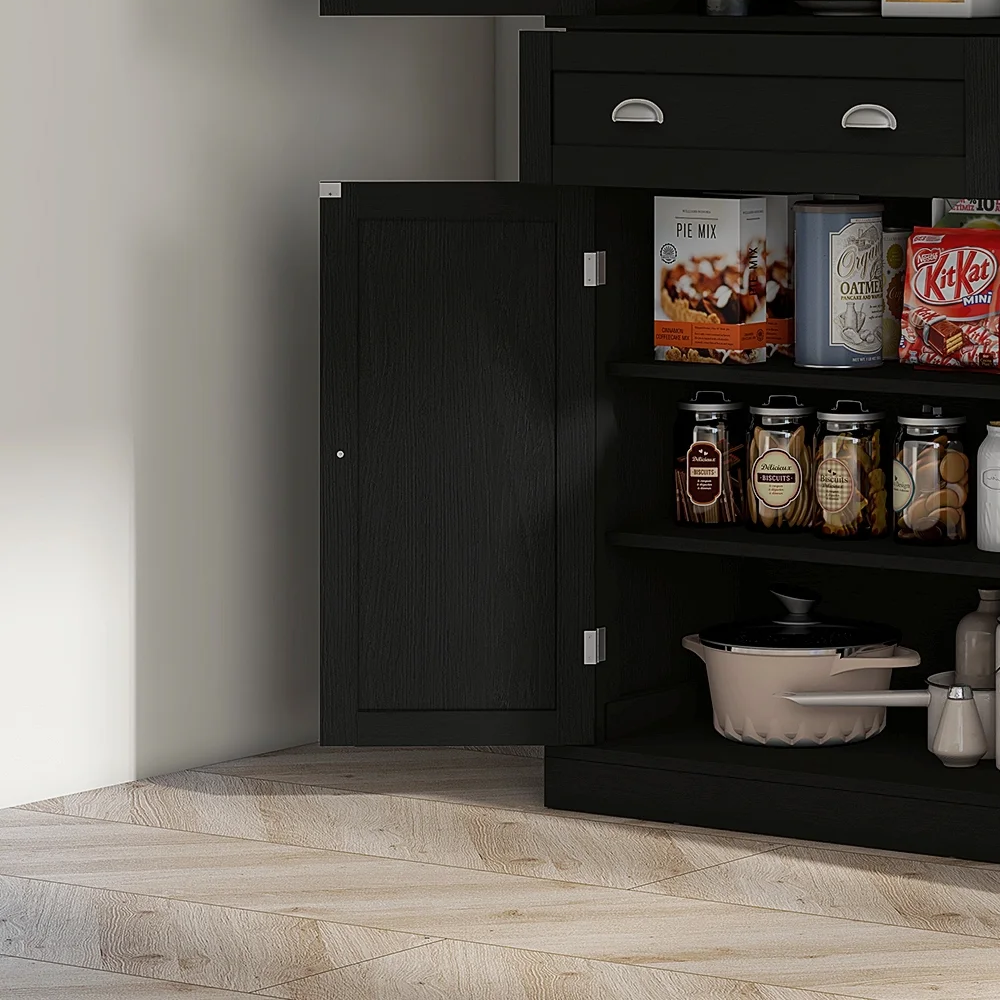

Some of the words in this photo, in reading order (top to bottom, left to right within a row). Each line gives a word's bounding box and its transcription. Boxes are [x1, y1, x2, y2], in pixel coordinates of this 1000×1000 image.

[676, 222, 692, 238] PIE
[698, 223, 717, 239] MIX
[749, 247, 758, 269] MIX
[924, 250, 990, 300] KitKat
[762, 474, 791, 482] BISCUITS
[820, 474, 849, 484] Biscuits
